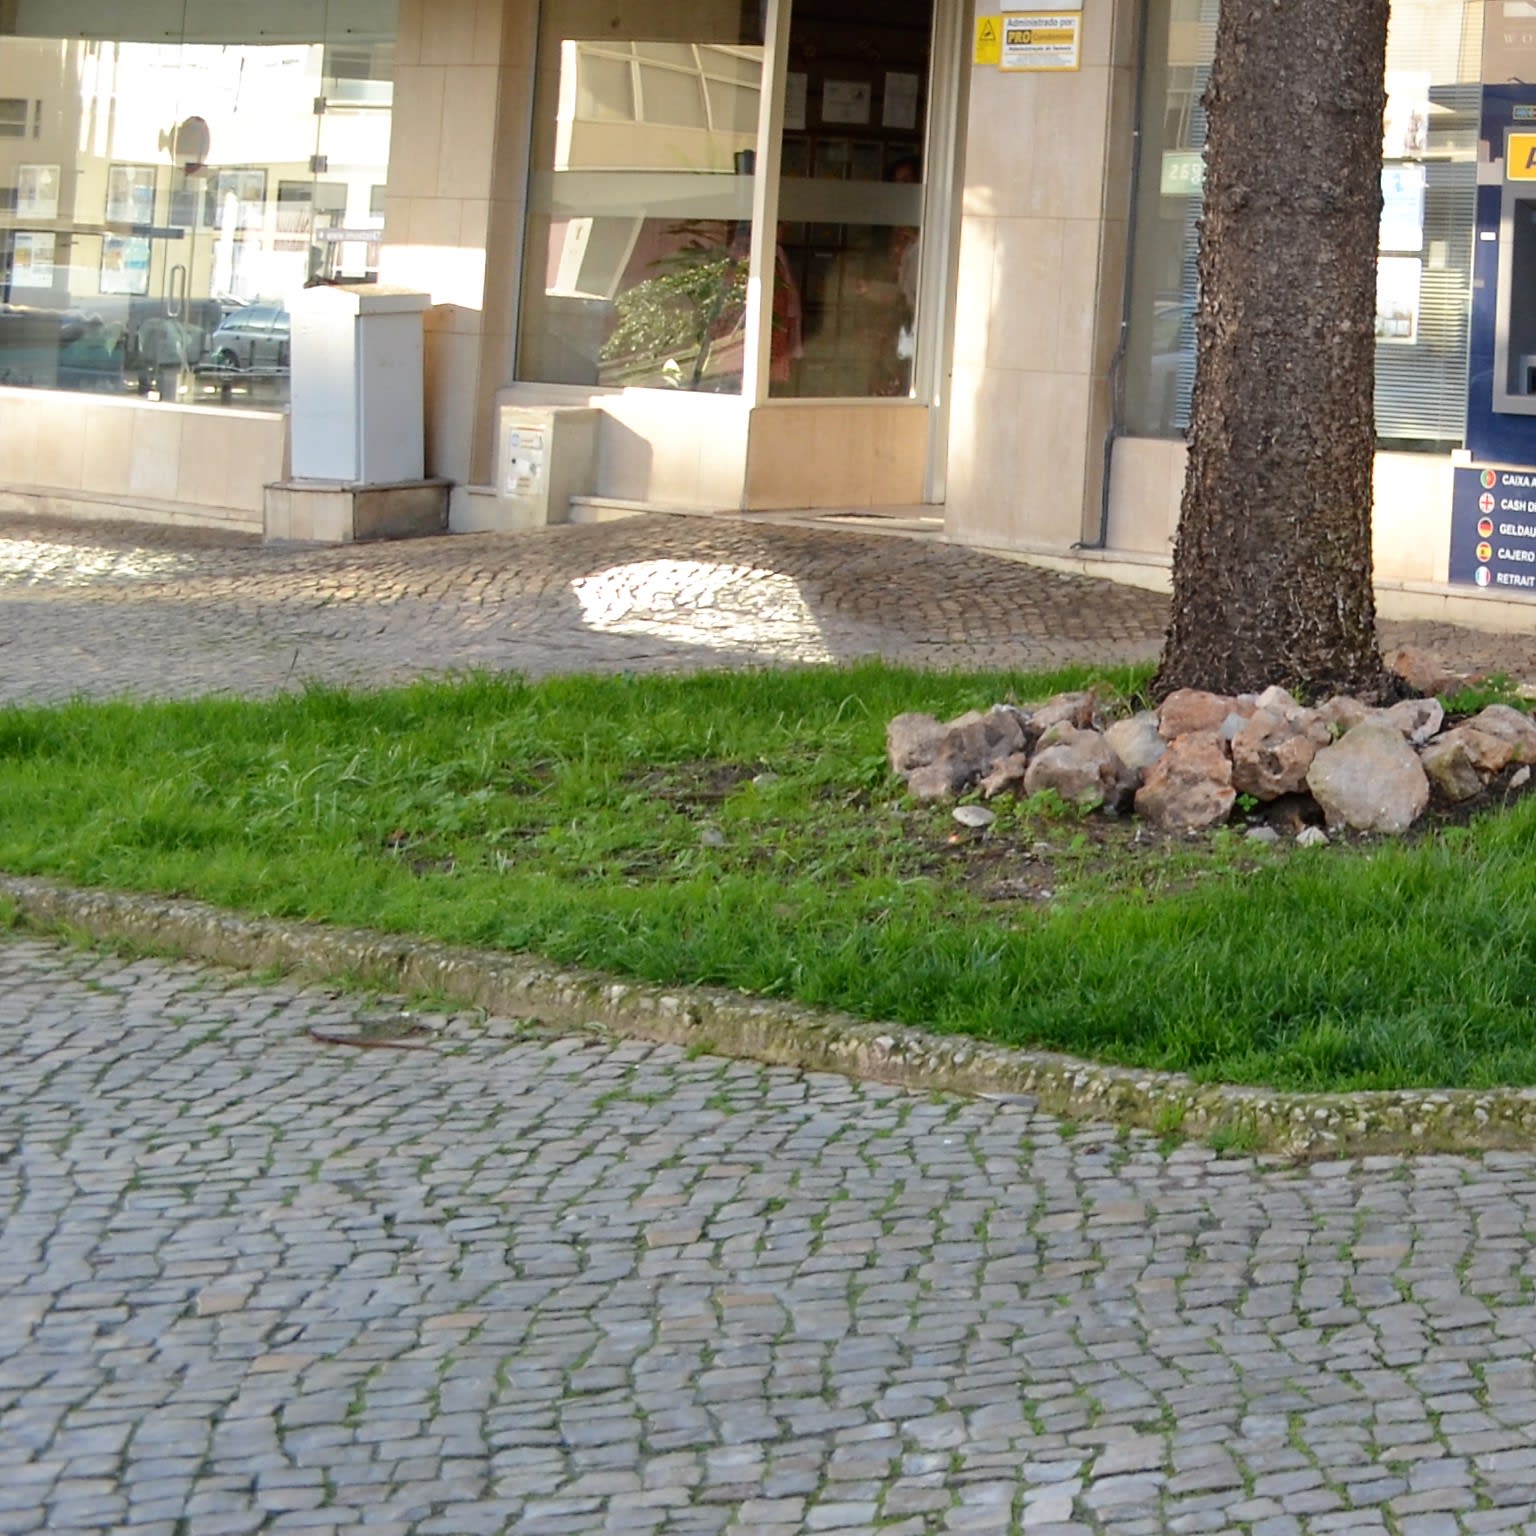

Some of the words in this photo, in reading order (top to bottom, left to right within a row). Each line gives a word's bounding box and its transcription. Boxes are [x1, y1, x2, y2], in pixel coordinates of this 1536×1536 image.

[1501, 474, 1531, 488] CAIXA
[1500, 498, 1527, 512] CASH
[1497, 547, 1535, 563] CAJERO
[1496, 572, 1536, 587] RETRAIT
